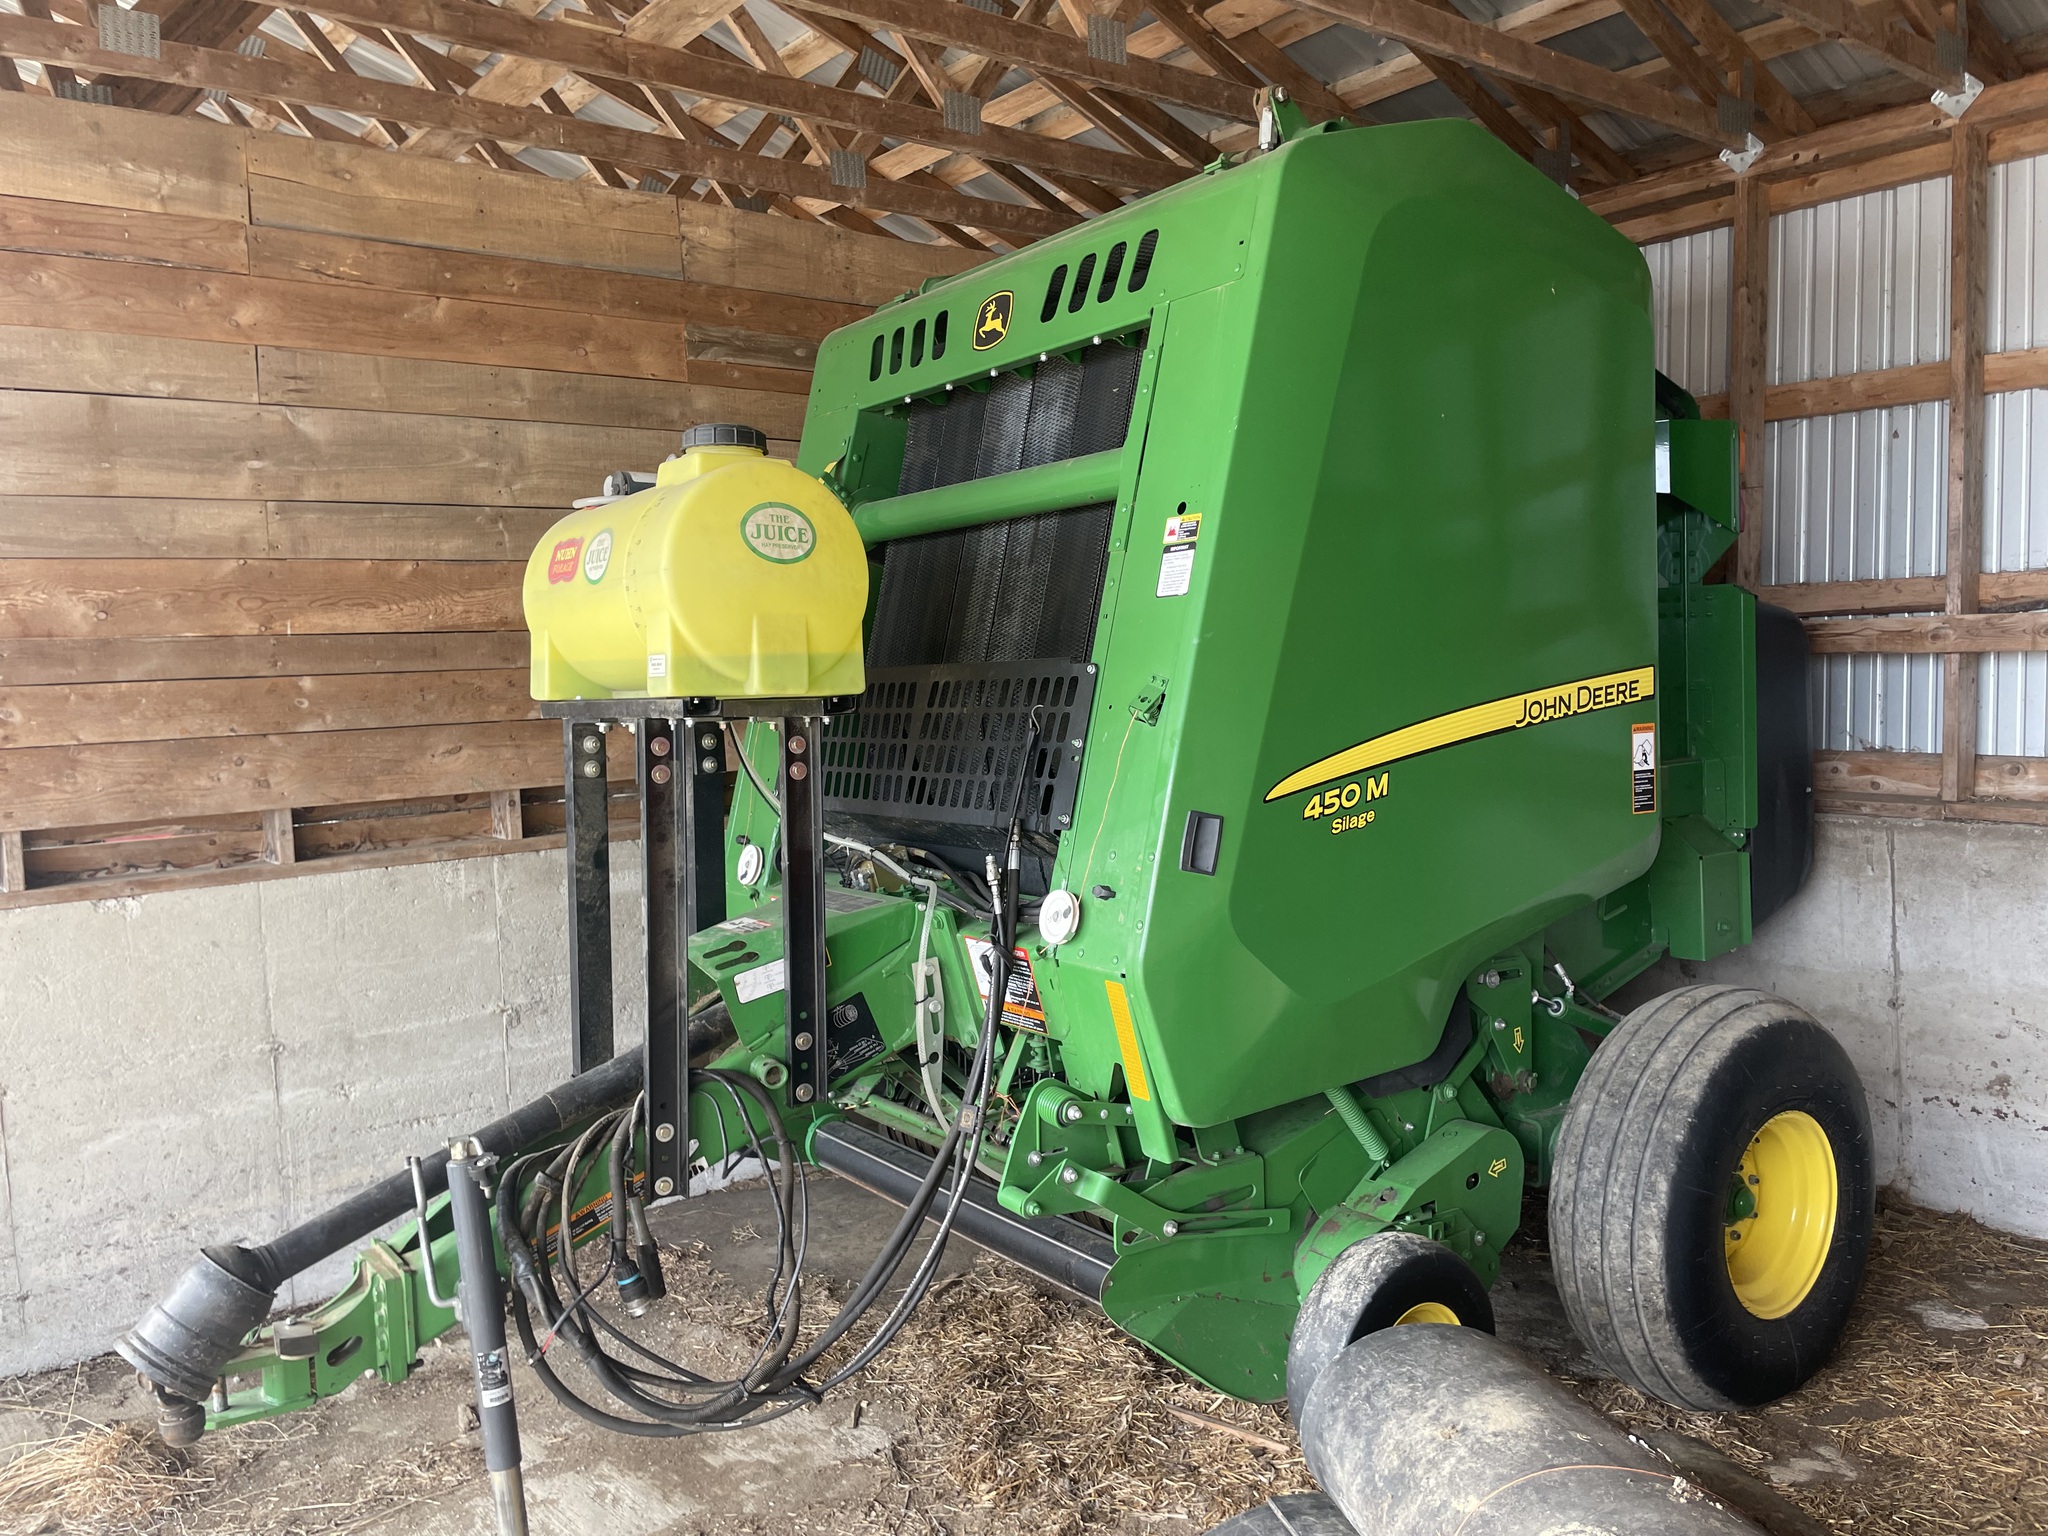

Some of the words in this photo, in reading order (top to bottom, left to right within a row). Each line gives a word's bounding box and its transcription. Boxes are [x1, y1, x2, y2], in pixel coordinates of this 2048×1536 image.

[769, 513, 790, 524] THE
[751, 523, 809, 544] JUICE
[586, 547, 609, 565] JUICE
[1516, 693, 1572, 724] JOHN
[1577, 679, 1640, 710] DEERE
[1303, 783, 1361, 819] 450
[1366, 772, 1389, 802] M
[1331, 810, 1376, 834] Silage
[579, 1196, 608, 1215] WARNING
